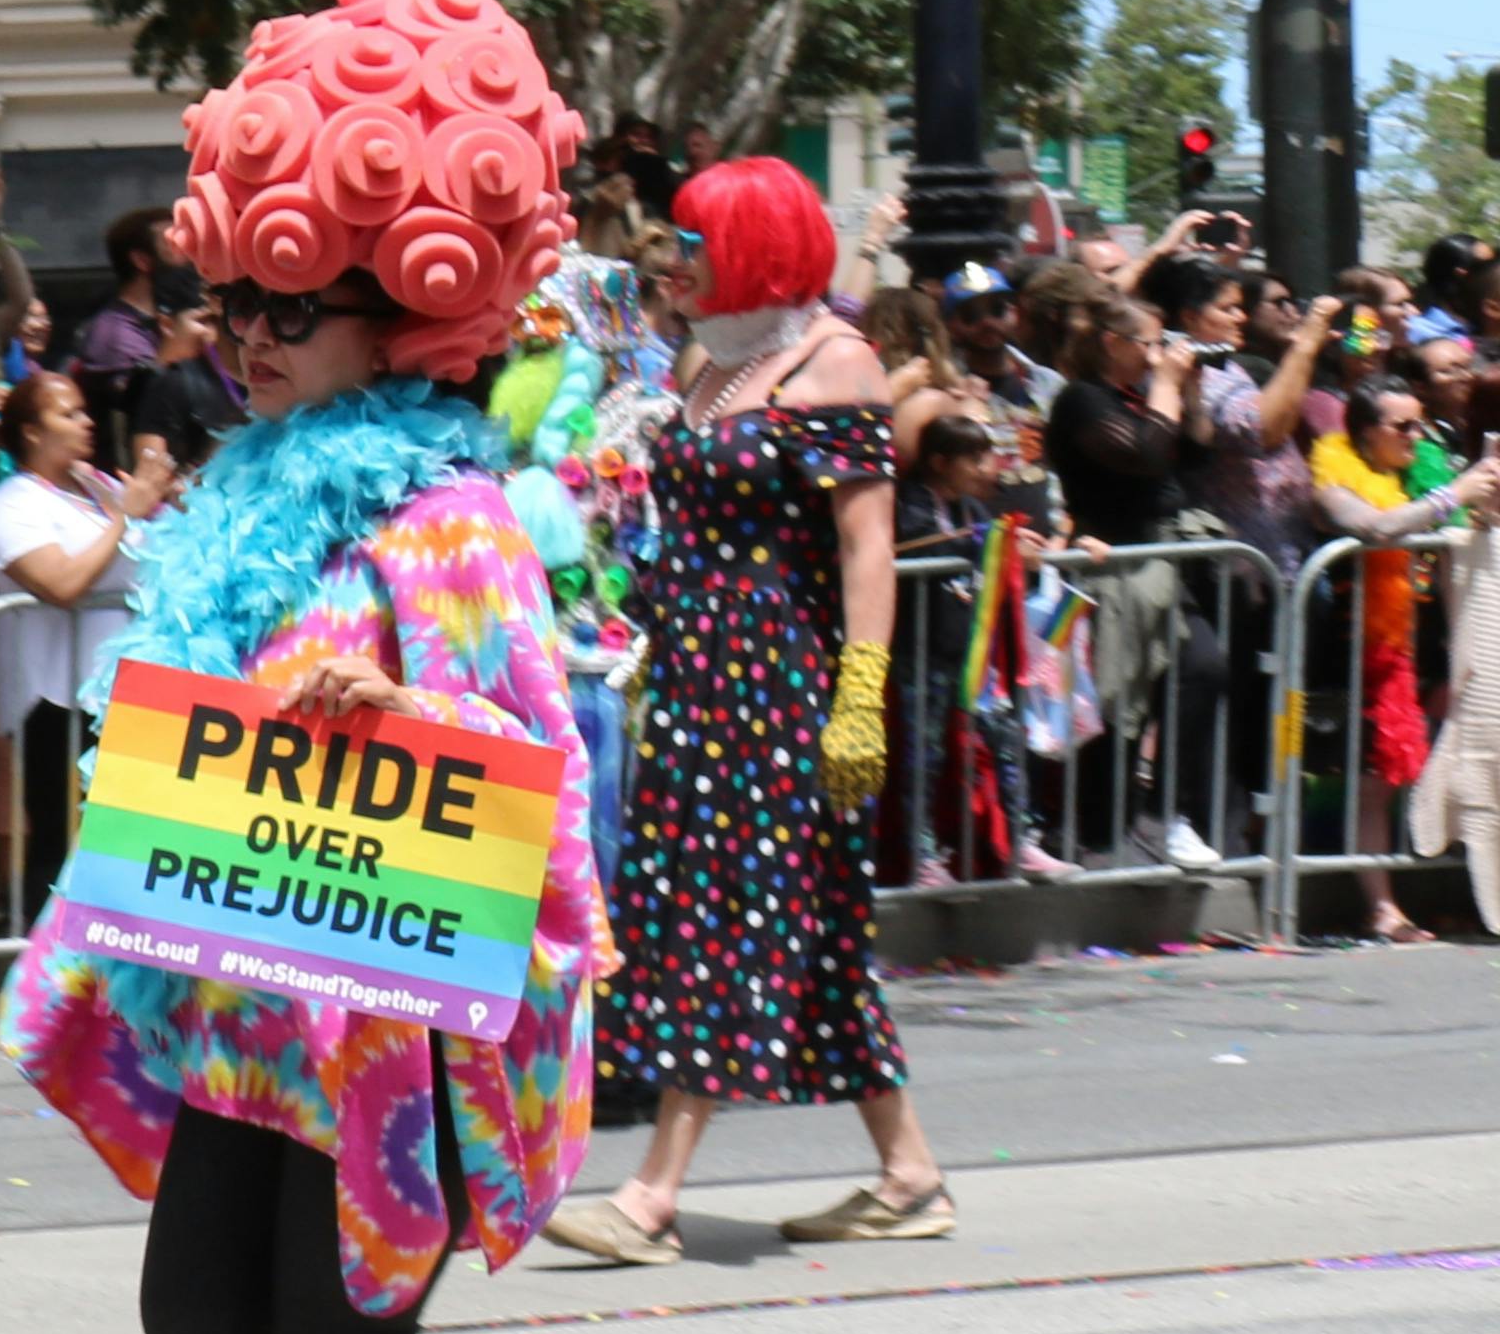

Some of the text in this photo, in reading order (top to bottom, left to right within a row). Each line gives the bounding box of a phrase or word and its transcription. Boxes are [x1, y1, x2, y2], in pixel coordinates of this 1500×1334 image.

[176, 703, 487, 841] PRIDE
[245, 814, 385, 880] OVER
[143, 847, 463, 957] PREJUDICE
[85, 922, 442, 1019] #GetLoud #WeStandTogether
